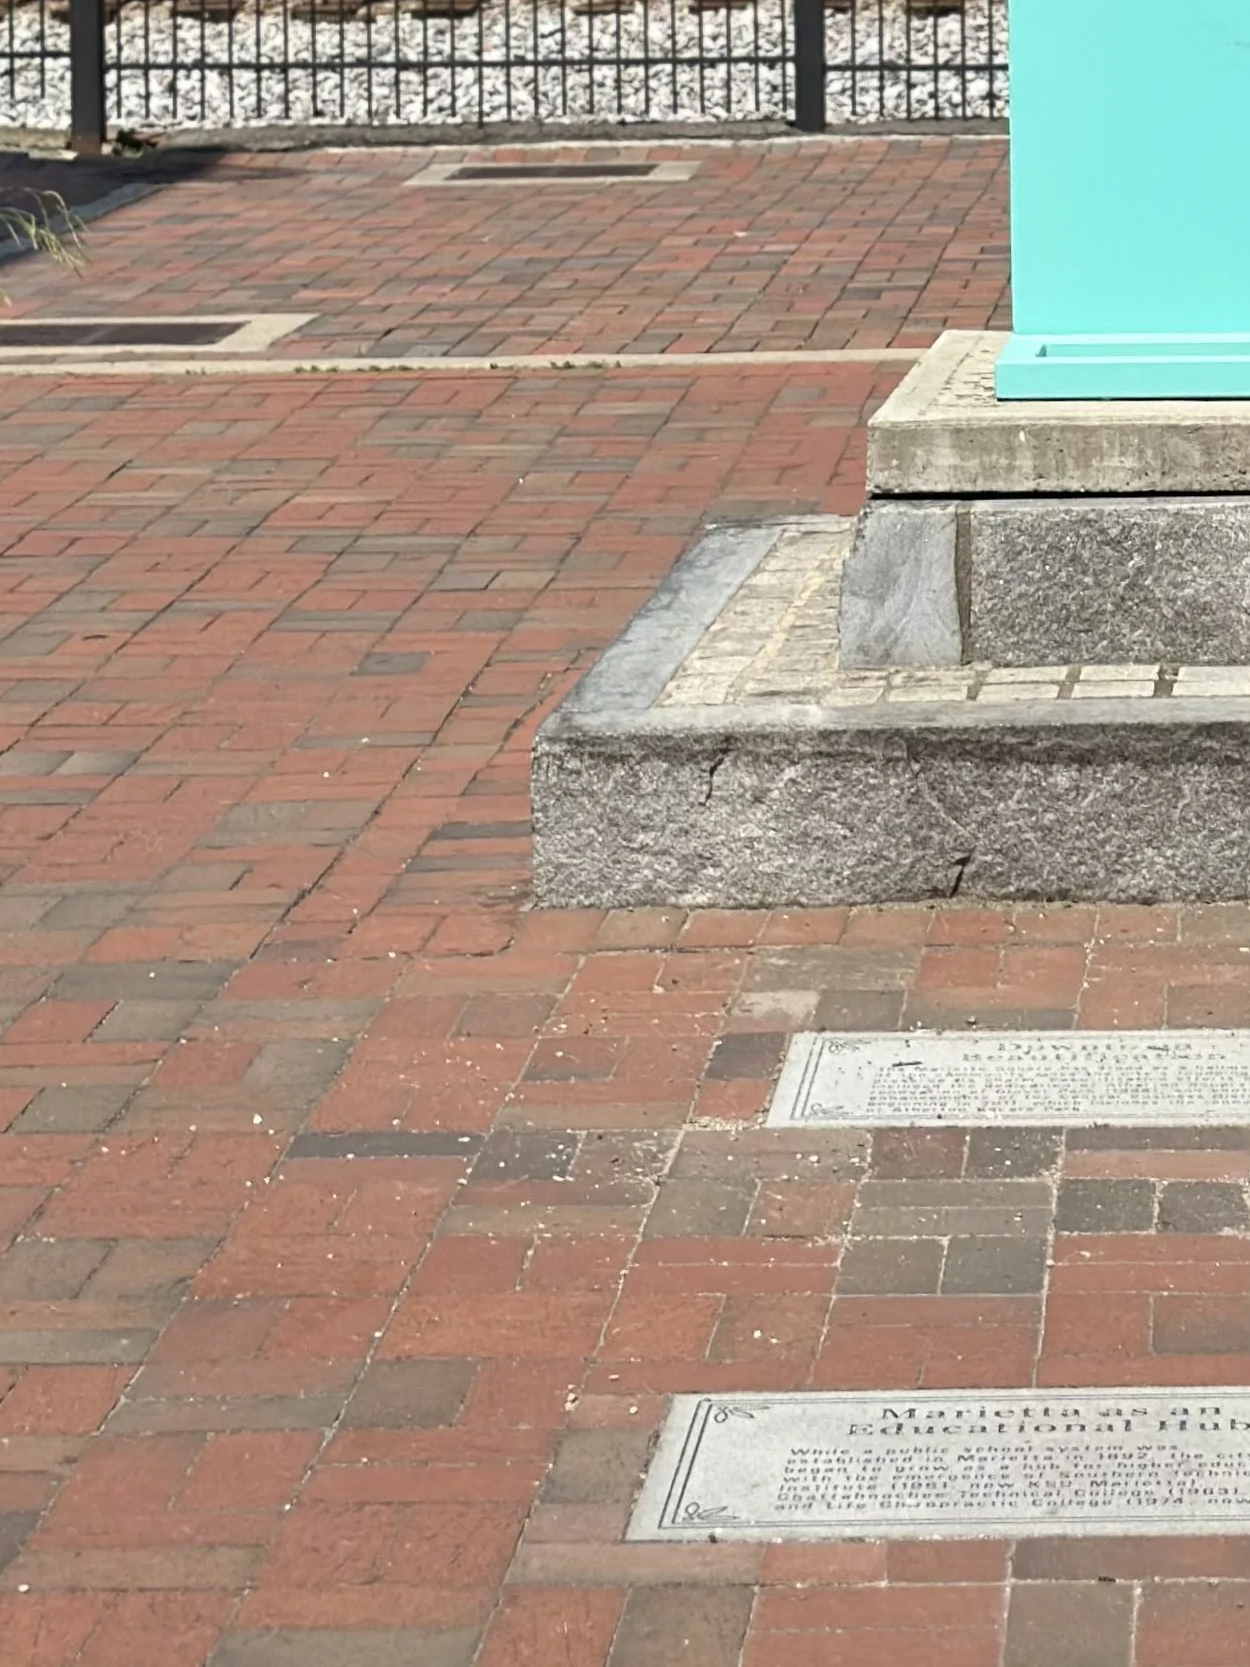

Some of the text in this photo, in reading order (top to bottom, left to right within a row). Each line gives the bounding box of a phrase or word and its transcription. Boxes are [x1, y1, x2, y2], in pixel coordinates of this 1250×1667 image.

[882, 1406, 1221, 1420] Marietta as an
[849, 1419, 1132, 1435] Educational
[886, 1446, 949, 1455] public
[964, 1445, 1033, 1453] school
[1046, 1445, 1122, 1453] system
[787, 1456, 913, 1464] established
[957, 1454, 1053, 1462] Marietta
[785, 1466, 848, 1474] began
[896, 1465, 949, 1473] grow
[1117, 1462, 1184, 1470] higher
[892, 1473, 1009, 1481] emergence
[1060, 1470, 1159, 1478] Southern
[780, 1484, 877, 1492] Institute
[778, 1491, 945, 1501] Chattahoochee
[961, 1489, 1060, 1498] Technical
[1074, 1488, 1155, 1497] College
[775, 1501, 812, 1510] and
[826, 1501, 867, 1510] Life
[880, 1498, 1016, 1508] Chiropractic
[1032, 1497, 1112, 1507] College
